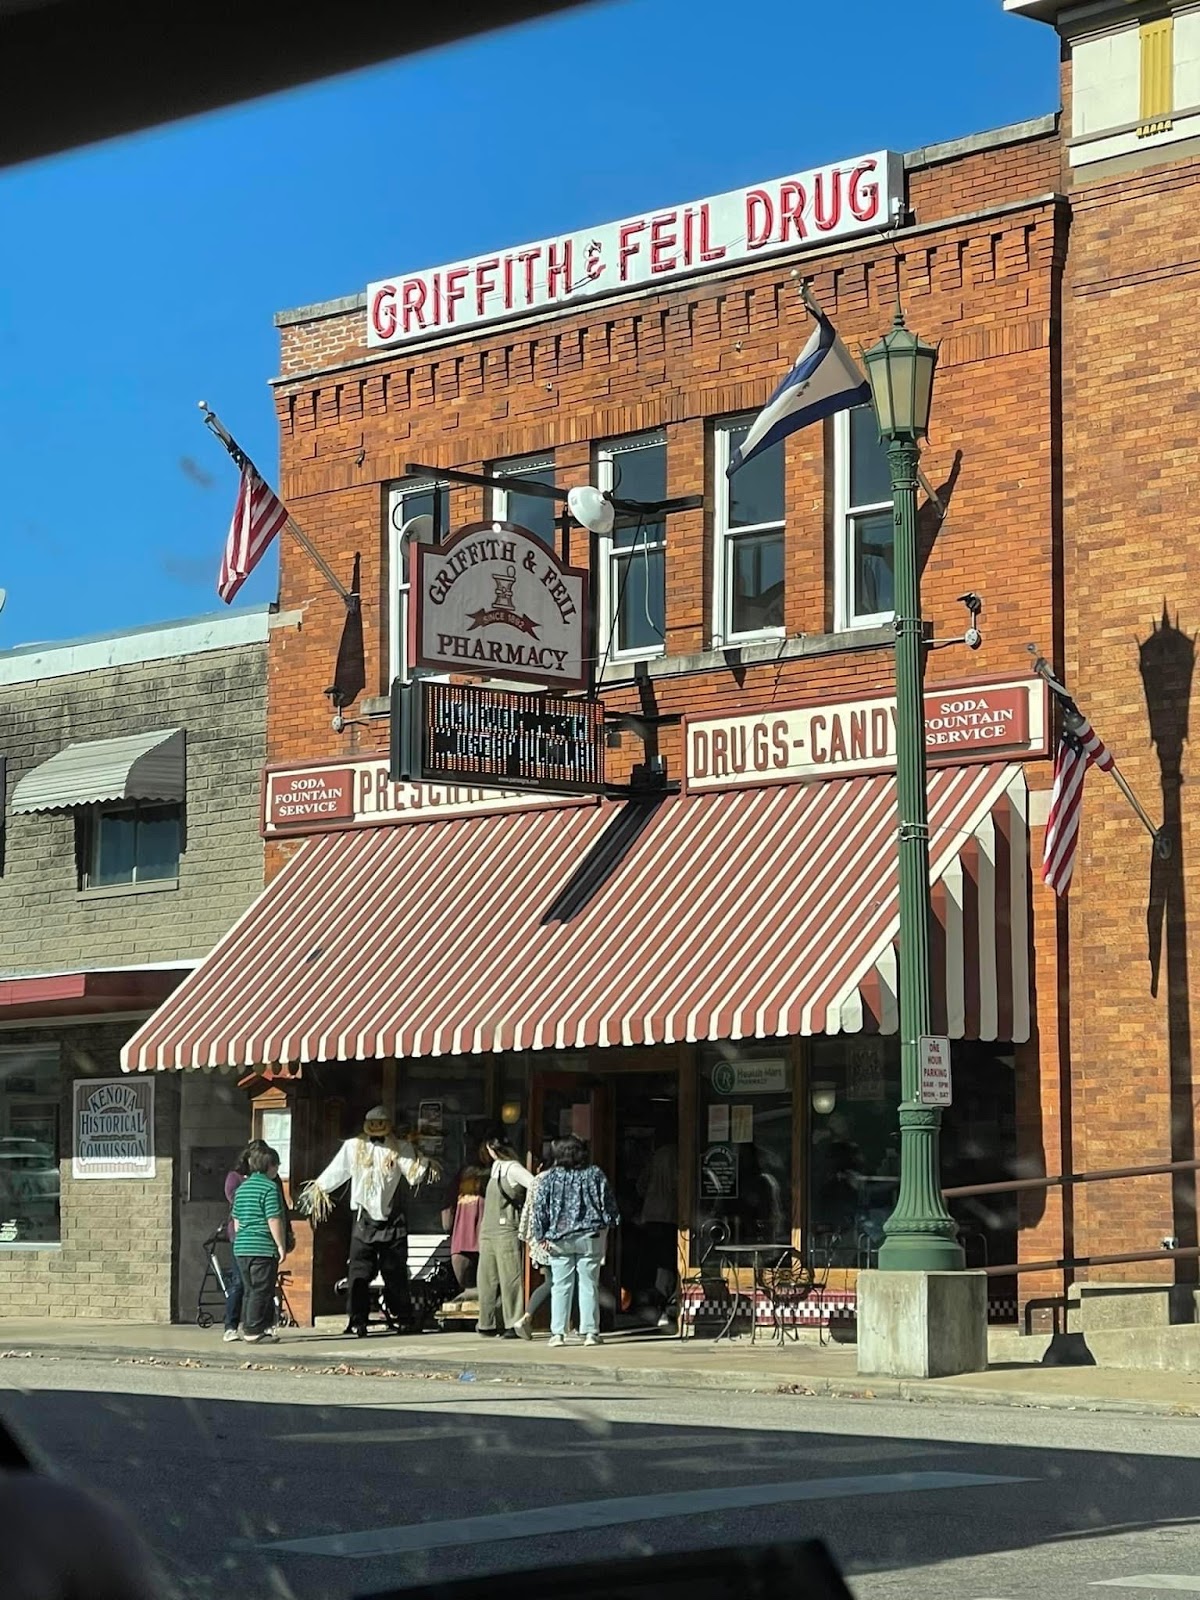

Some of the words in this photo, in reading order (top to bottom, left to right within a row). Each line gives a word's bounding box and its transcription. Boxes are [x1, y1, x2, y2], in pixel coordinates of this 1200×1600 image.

[372, 239, 573, 340] GRIFFITH
[585, 239, 607, 279] &
[618, 204, 727, 281] FEIL
[746, 159, 880, 251] DRUG
[429, 539, 517, 605] GRIFFITH
[522, 550, 536, 574] &
[539, 567, 577, 625] FEIL
[483, 612, 505, 624] SINCE
[508, 614, 525, 629] 1892
[437, 633, 569, 671] PHARMACY
[940, 698, 989, 715] SODA
[926, 725, 1007, 745] SERVICE
[290, 778, 326, 791] SODA
[274, 787, 342, 805] FOUNTAIN
[278, 801, 337, 817] SERVICE
[924, 1068, 947, 1078] PARKING
[90, 1087, 136, 1113] KENOVA
[81, 1112, 145, 1135] HISTORICAL
[80, 1139, 145, 1161] COMMISSION
